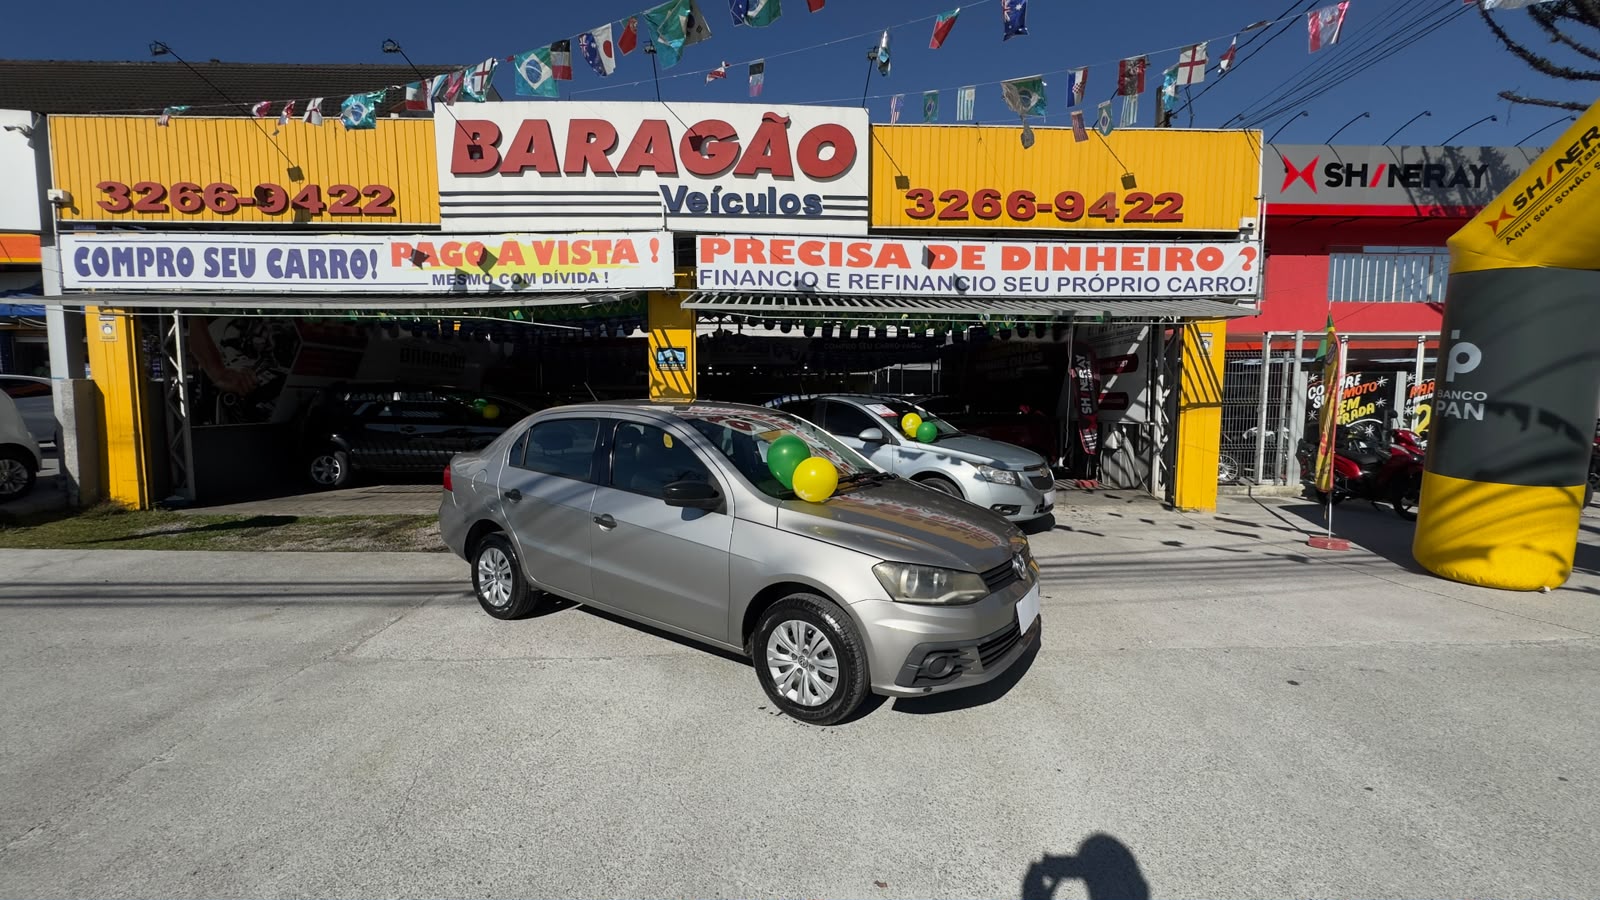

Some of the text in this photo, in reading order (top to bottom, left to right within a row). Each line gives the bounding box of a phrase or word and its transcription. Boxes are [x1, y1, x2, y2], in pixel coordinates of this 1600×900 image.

[450, 111, 858, 182] BARAGÃO
[1324, 162, 1490, 189] SHINERAY
[1512, 125, 1600, 212] SHINER
[96, 181, 397, 218] 3266-9422
[659, 185, 824, 216] Veículos
[905, 188, 1185, 223] 3266-9422
[1506, 221, 1532, 245] Aqui
[73, 246, 378, 279] COMPRO SEU CARRO!
[391, 240, 488, 268] PAGO
[498, 240, 526, 266] A
[532, 238, 640, 266] VISTA
[700, 238, 1257, 272] PRECISA DE DINHEIRO ?
[432, 272, 494, 286] MESMO
[499, 272, 537, 285] COM
[542, 269, 599, 285] DÍVIDA
[699, 269, 1254, 293] FINANCIO E REFINANCIO SEU PRÓPRIO CARRO!
[1343, 381, 1378, 400] MOTO
[1435, 389, 1488, 421] BANCO PAN
